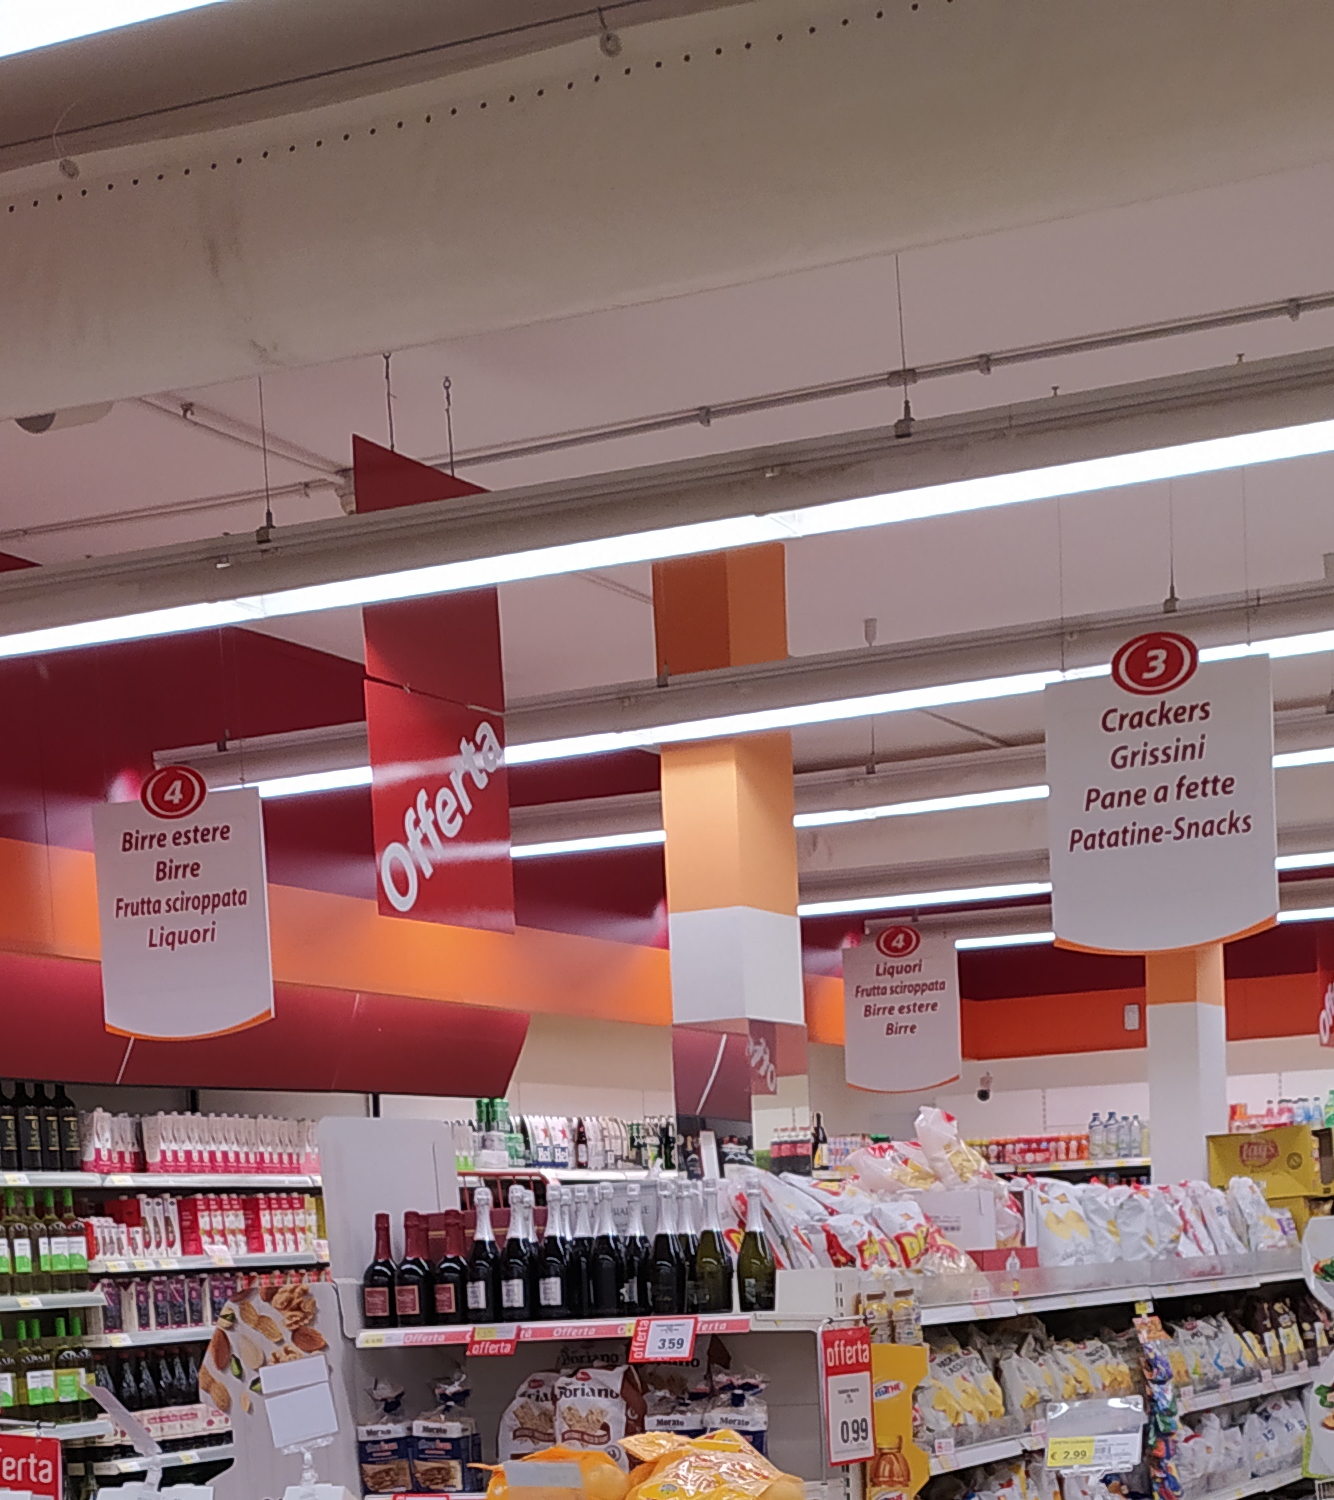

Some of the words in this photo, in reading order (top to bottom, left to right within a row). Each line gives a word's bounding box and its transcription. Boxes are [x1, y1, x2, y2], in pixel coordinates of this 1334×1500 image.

[1141, 648, 1168, 681] 3
[1100, 699, 1212, 733] Crackers
[1109, 733, 1207, 771] Grissini
[164, 779, 184, 805] 4
[1084, 787, 1148, 813] Pane
[1153, 784, 1170, 804] a
[1175, 774, 1236, 802] fette
[379, 720, 505, 912] Offerta
[120, 829, 168, 853] Birre
[171, 824, 231, 848] estere
[1069, 809, 1253, 853] Patatine-Snacks
[155, 858, 201, 882] Birre
[114, 894, 163, 919] Frutta
[164, 887, 249, 915] sciroppata
[147, 921, 217, 952] Liquori
[890, 932, 906, 949] 4
[875, 958, 923, 979] Liquori
[854, 984, 888, 999] Frutta
[889, 979, 947, 997] sciroppata
[863, 1003, 896, 1019] Birre
[897, 1000, 939, 1016] estere
[885, 1021, 918, 1036] Birre
[552, 1325, 597, 1338] Offerta
[633, 1319, 650, 1360] offerta
[471, 1341, 513, 1356] offerta
[825, 1338, 871, 1367] offerta
